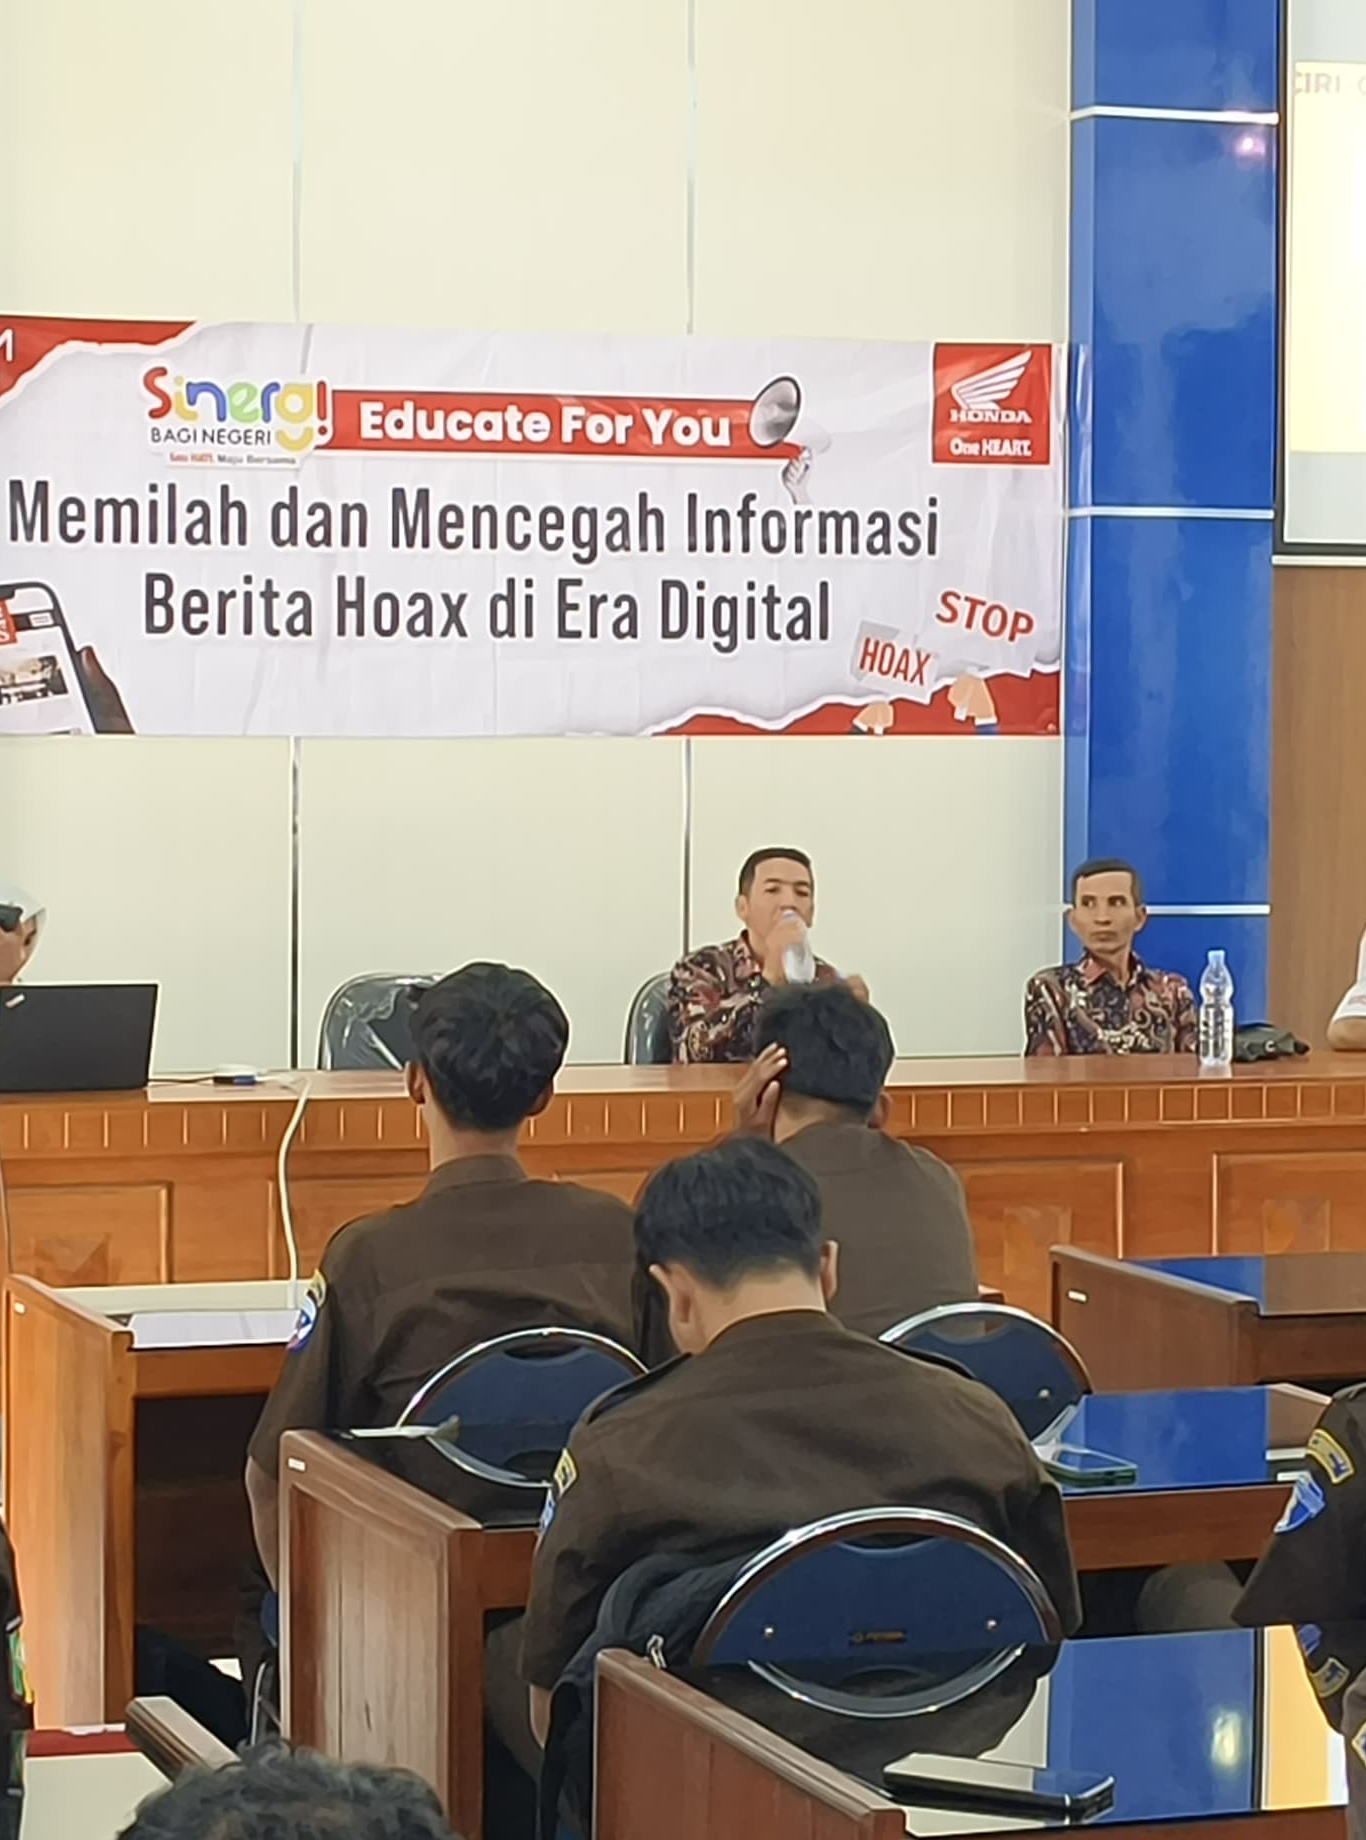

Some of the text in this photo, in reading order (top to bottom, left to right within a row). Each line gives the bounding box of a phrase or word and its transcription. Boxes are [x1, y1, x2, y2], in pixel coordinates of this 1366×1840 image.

[151, 427, 271, 445] BAGI NEGERI
[360, 401, 730, 447] Educate For You
[950, 409, 1033, 424] HONDA
[949, 438, 980, 456] One
[8, 479, 938, 564] Memilah dan Mencegah Informasi
[145, 572, 830, 653] Berita Hoax di Era Digital
[936, 591, 1035, 643] STOP
[859, 637, 932, 686] HOAX
